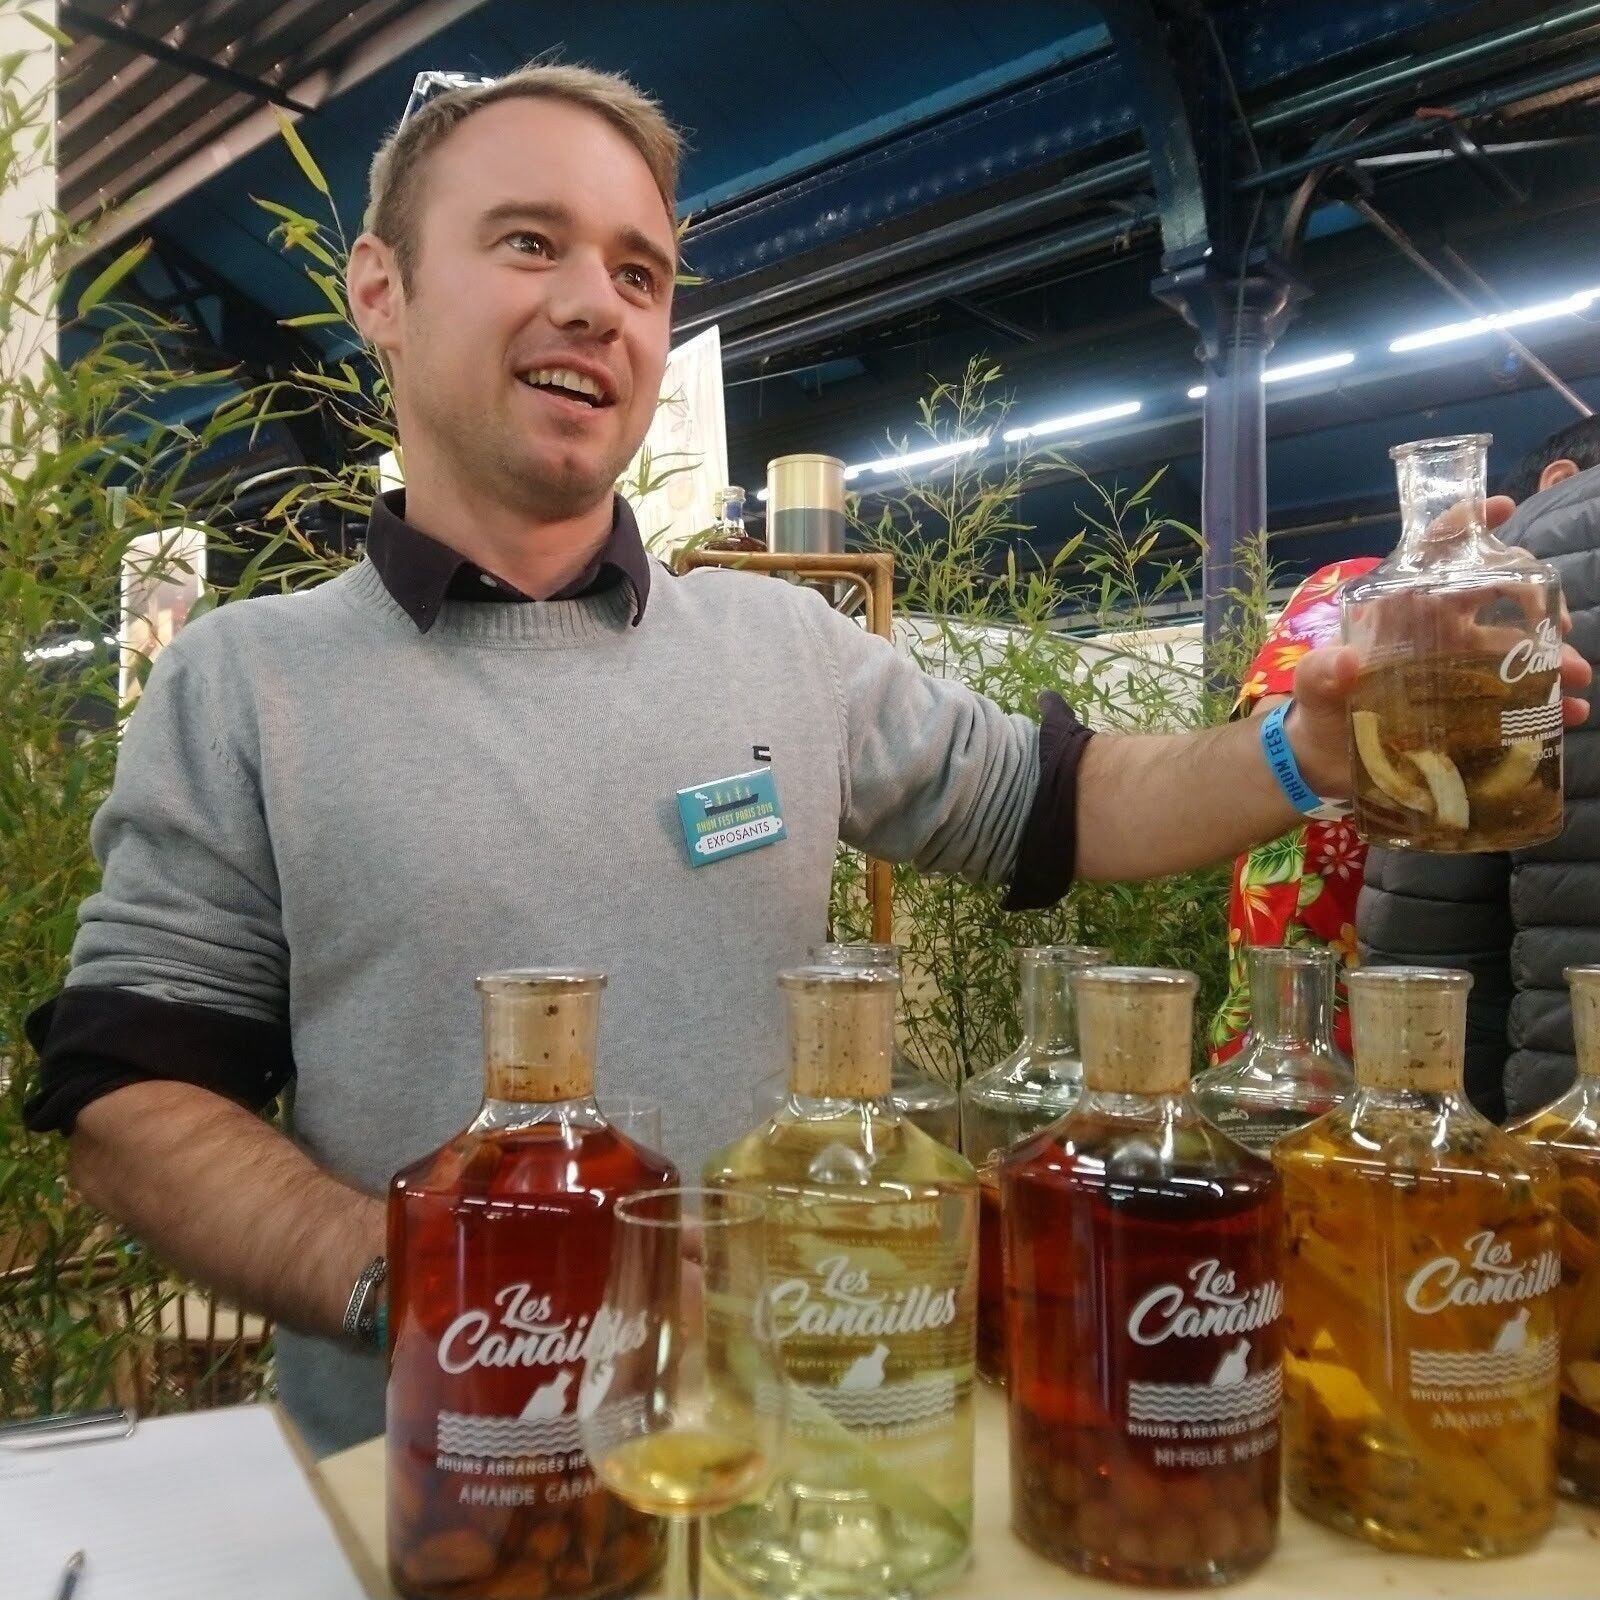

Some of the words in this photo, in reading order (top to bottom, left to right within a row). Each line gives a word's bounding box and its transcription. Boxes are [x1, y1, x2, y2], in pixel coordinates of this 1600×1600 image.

[1264, 721, 1285, 756] FEST
[1274, 758, 1309, 802] RHUM
[696, 818, 718, 834] RHUM
[718, 813, 734, 827] FEST
[735, 806, 756, 823] PARIS
[756, 801, 774, 817] 2019
[706, 821, 770, 850] EXPOSANTS
[1464, 1231, 1526, 1275] Les
[813, 1256, 888, 1304] Les
[1188, 1259, 1249, 1306] Les
[495, 1282, 571, 1334] Les
[754, 1278, 956, 1342] Canailles
[1127, 1423, 1179, 1439] RHUMS
[436, 1455, 482, 1475] RHUMS
[458, 1482, 536, 1506] AMANDE
